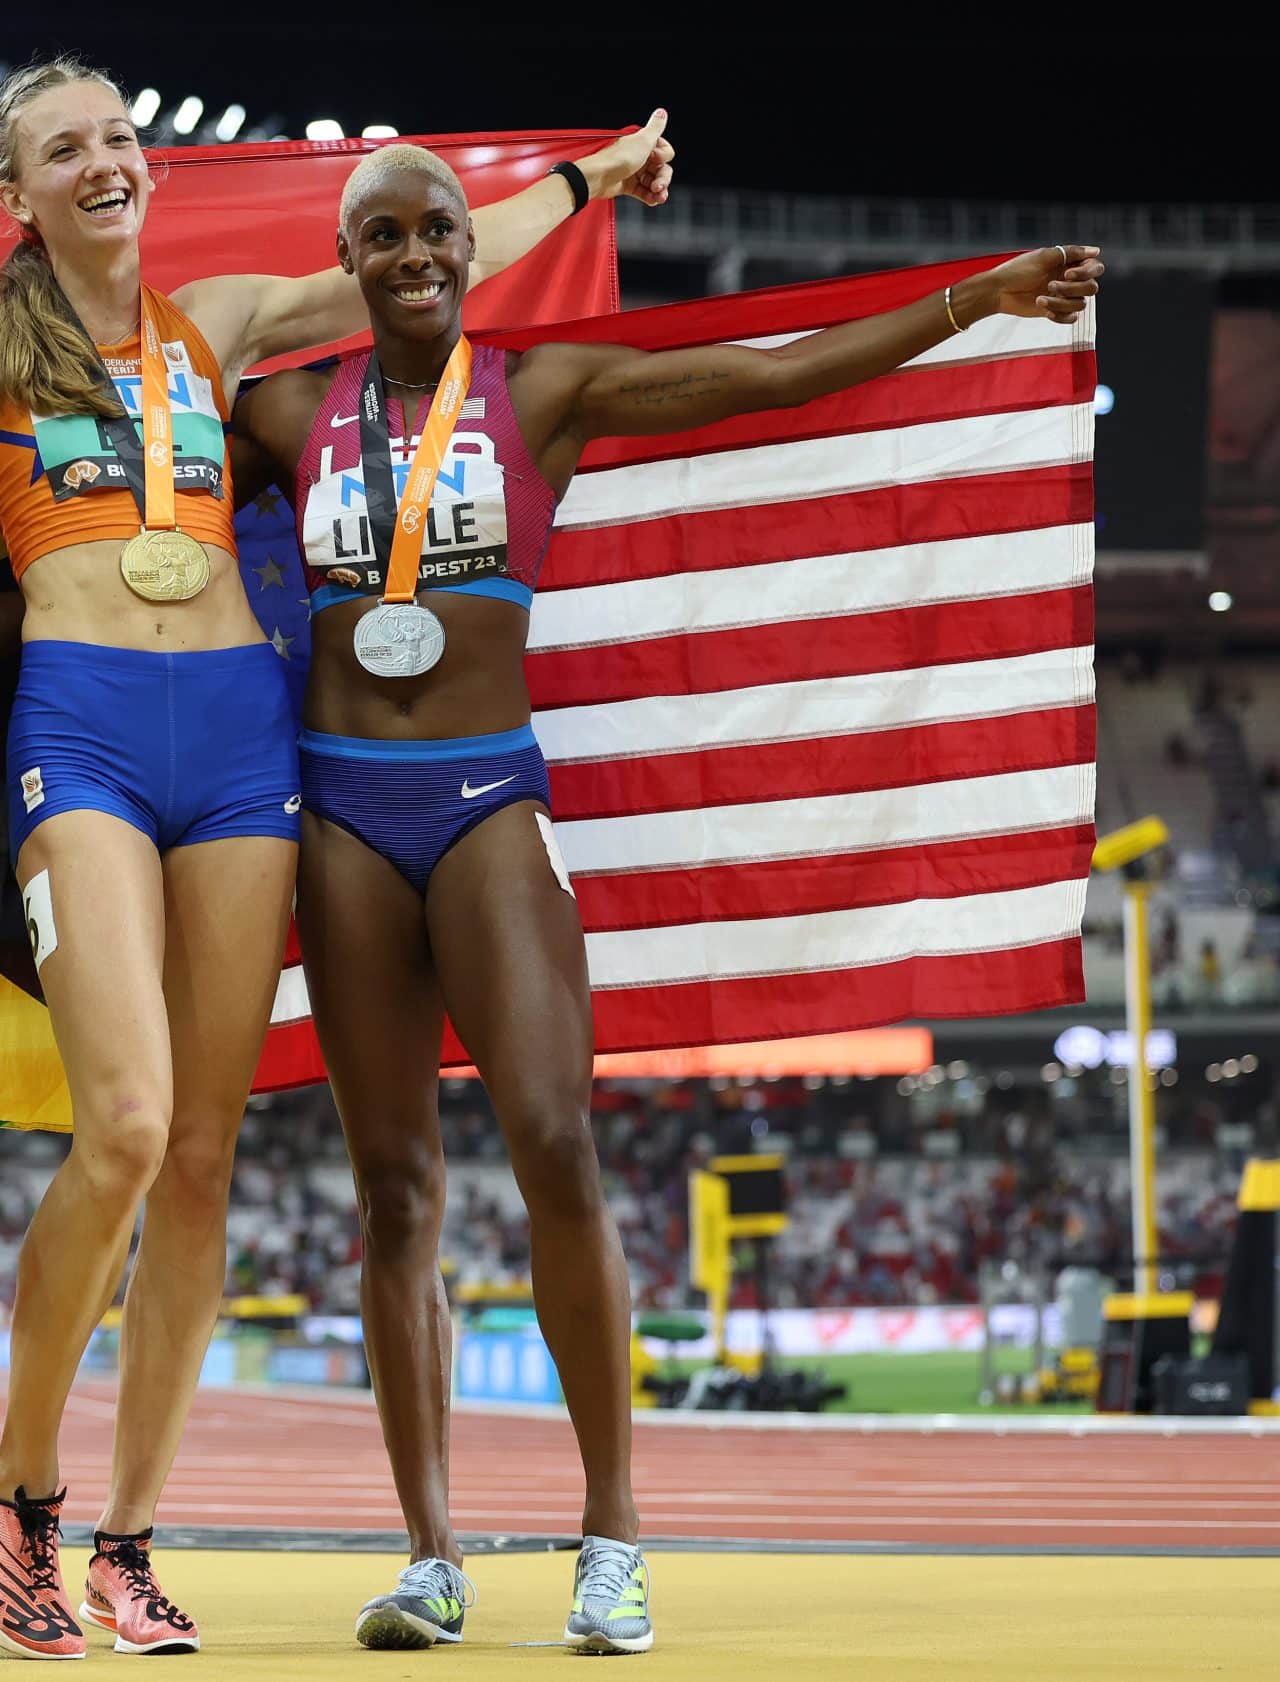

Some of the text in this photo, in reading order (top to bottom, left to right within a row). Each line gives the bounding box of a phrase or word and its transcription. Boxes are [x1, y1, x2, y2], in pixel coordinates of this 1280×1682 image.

[332, 501, 479, 559] LILE
[367, 555, 497, 585] BPEST 23
